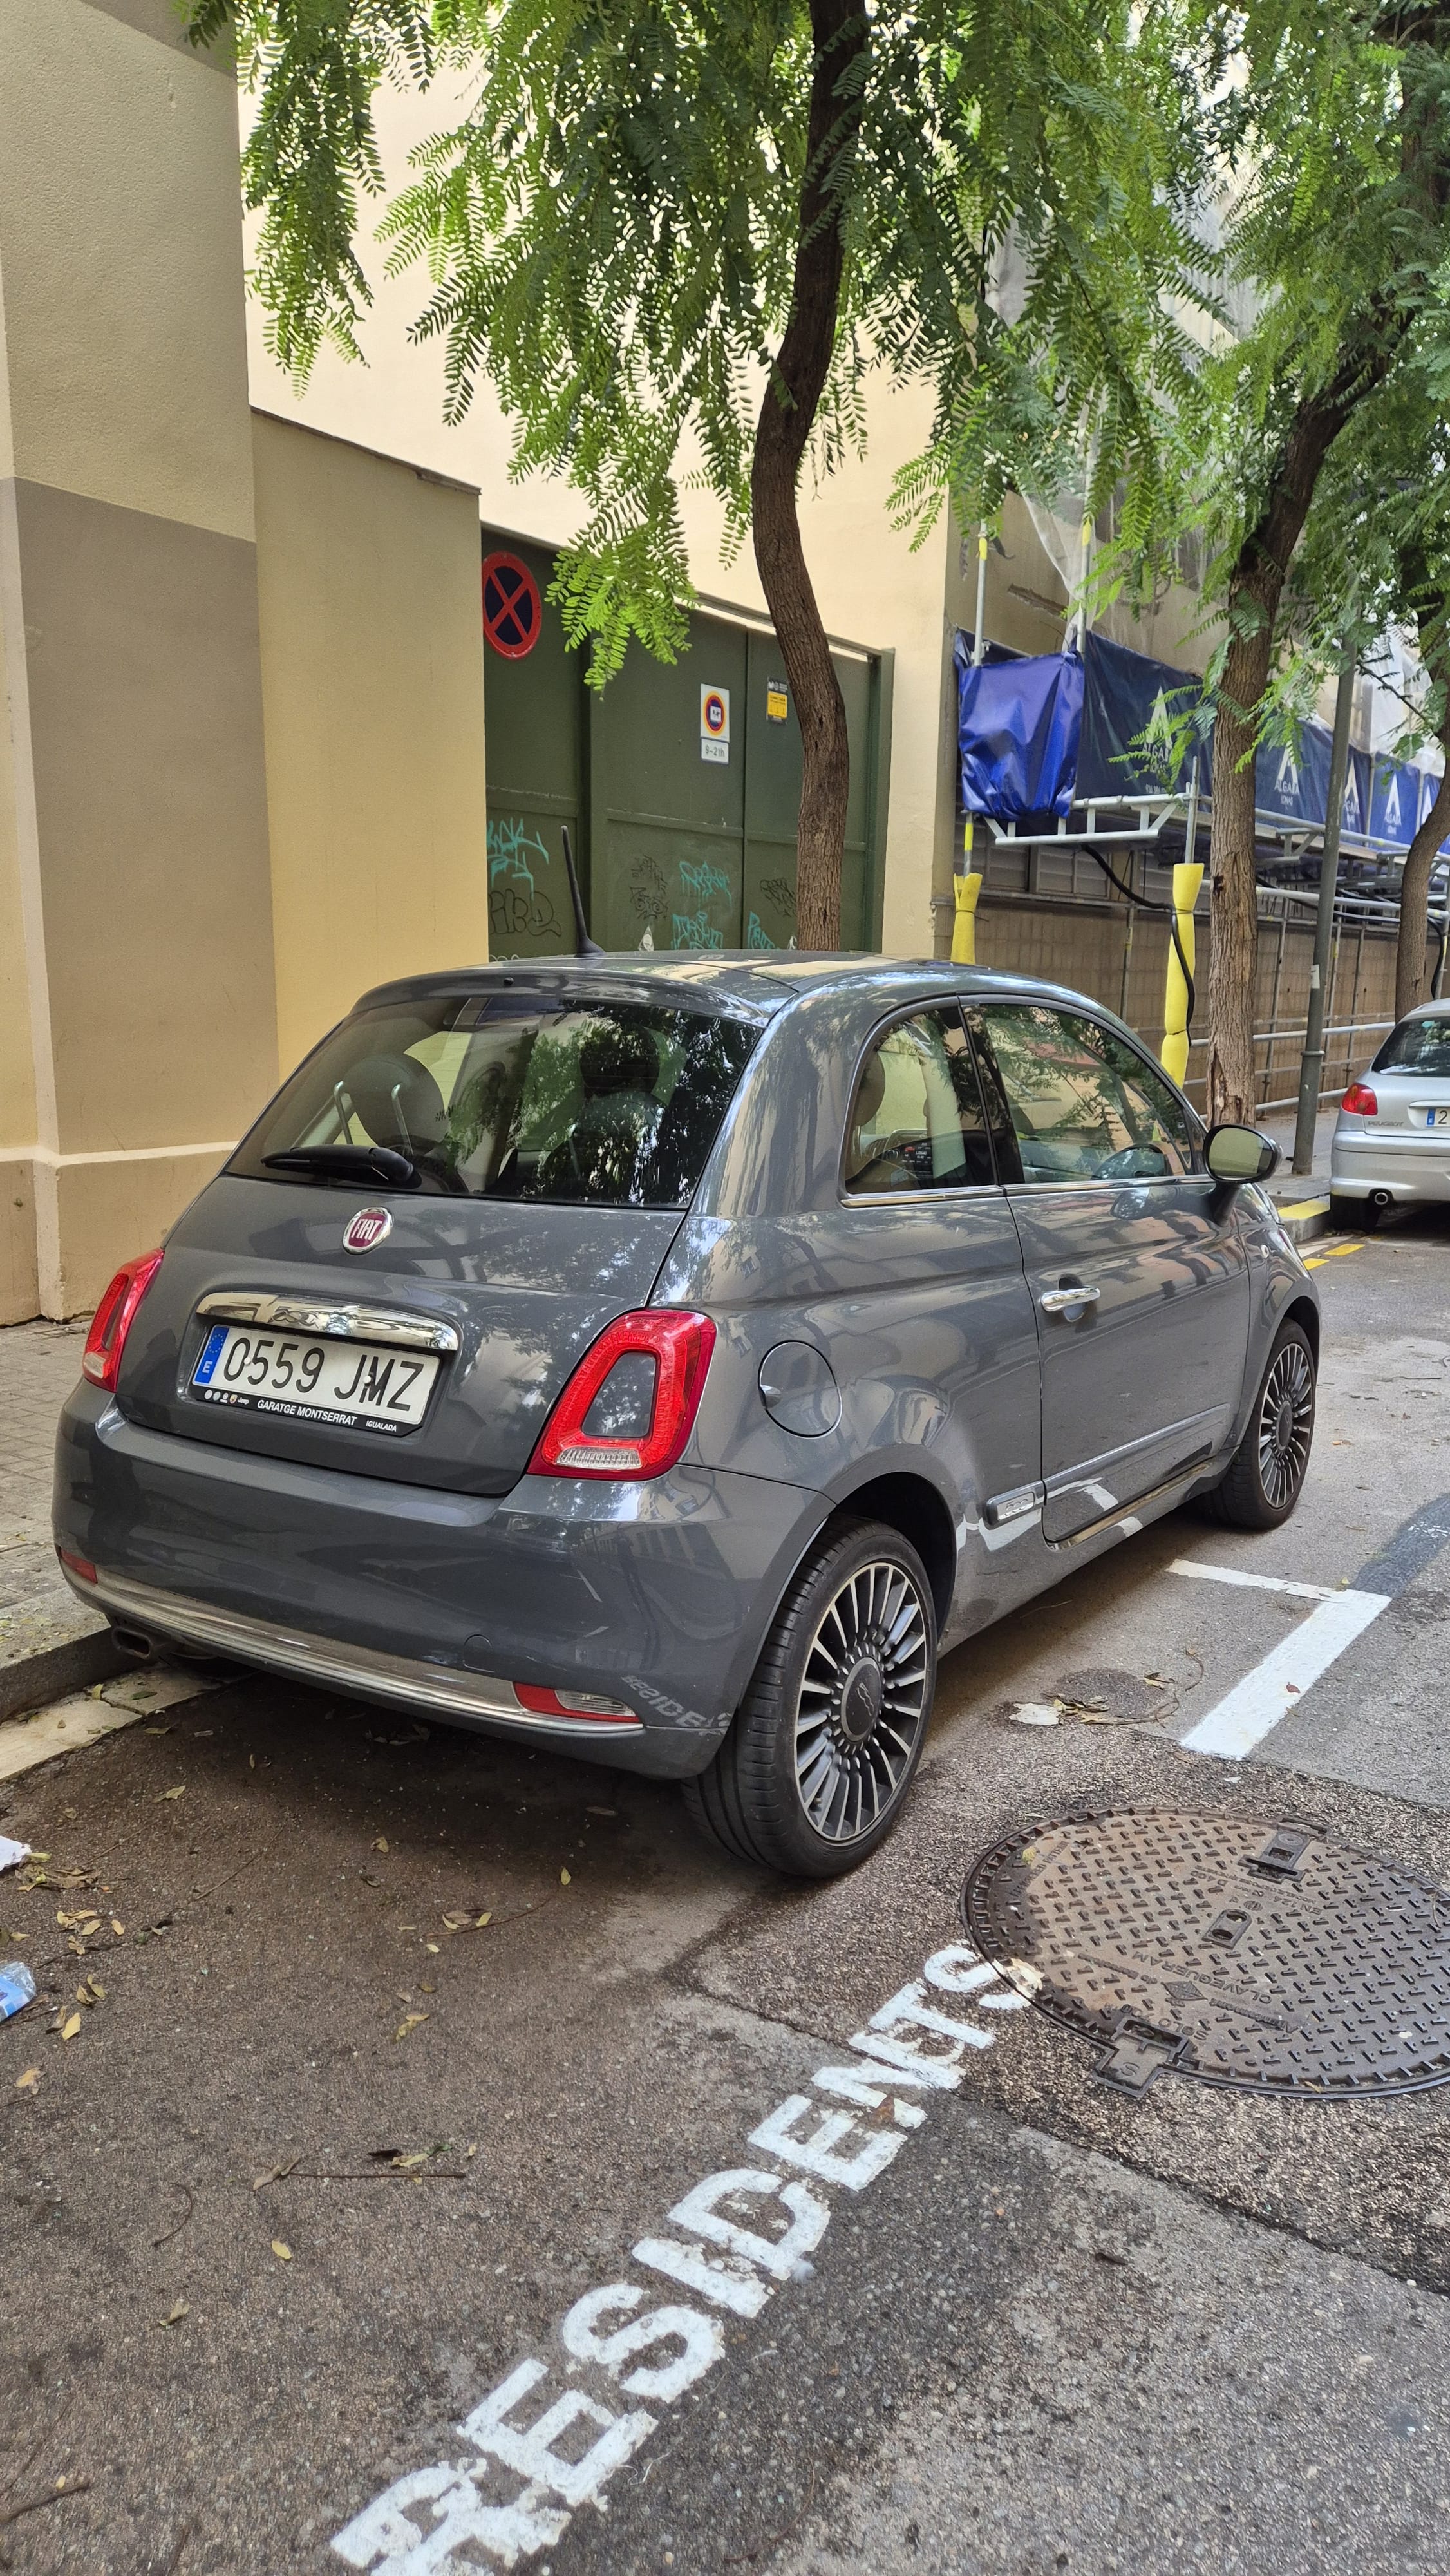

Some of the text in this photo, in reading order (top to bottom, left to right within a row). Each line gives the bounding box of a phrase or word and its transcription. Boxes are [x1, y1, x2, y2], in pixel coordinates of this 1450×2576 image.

[351, 1218, 383, 1240] FIAT
[202, 1337, 424, 1412] E 0559 JMZ
[258, 1399, 298, 1415] GARATGE
[296, 1406, 357, 1425] MONTSERRAT
[366, 1420, 397, 1432] IGUALADA
[1300, 1903, 1323, 1915] EN
[1132, 1951, 1272, 2004] CLAVEGUERAM
[330, 1940, 1031, 2576] RESIDENTS
